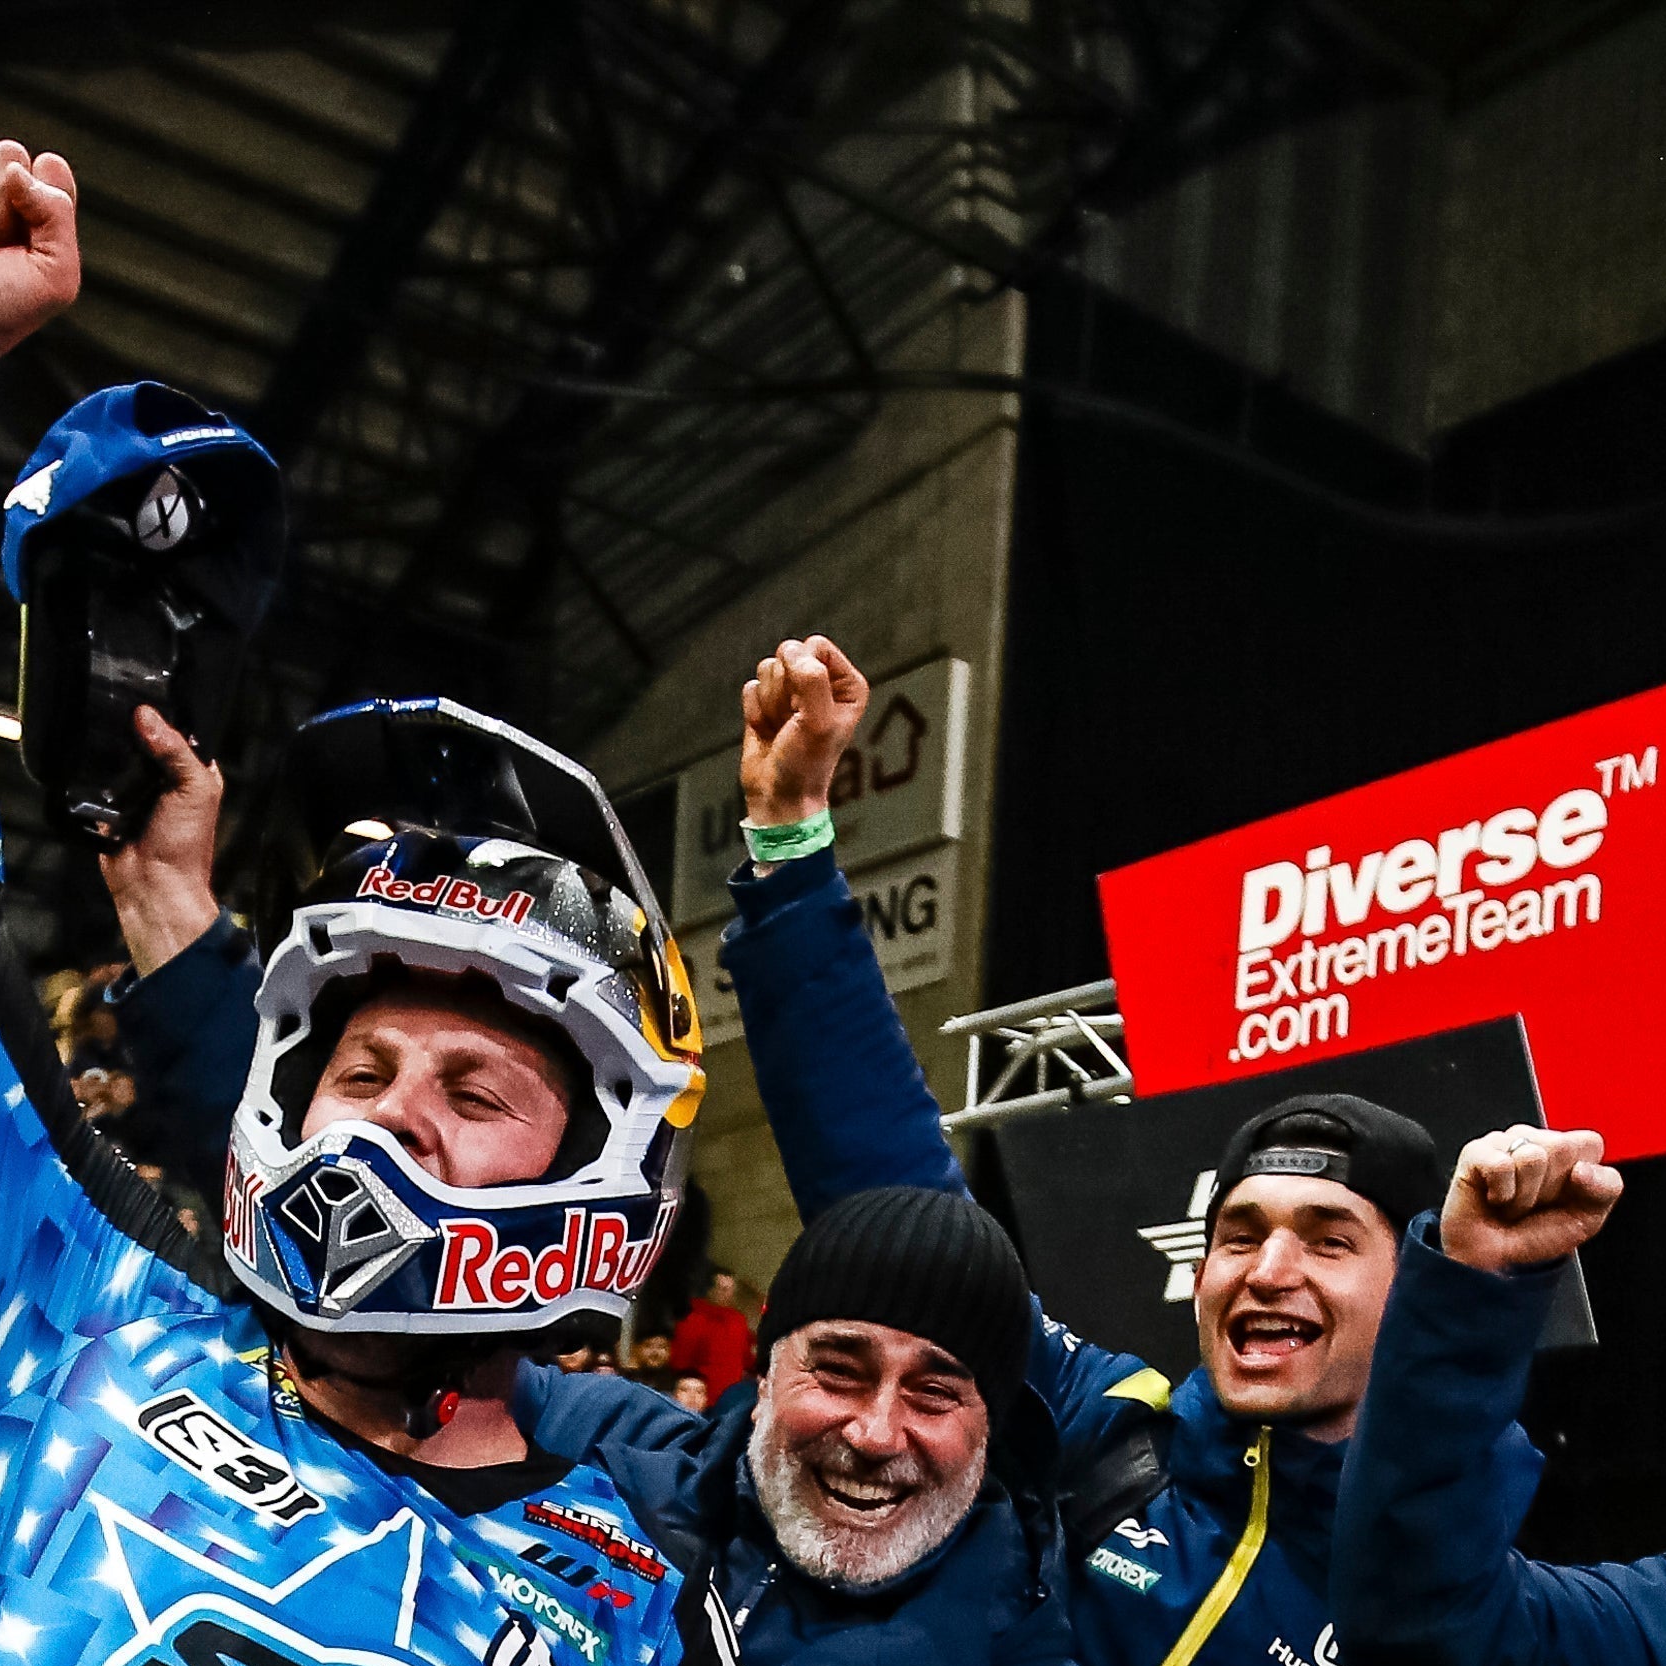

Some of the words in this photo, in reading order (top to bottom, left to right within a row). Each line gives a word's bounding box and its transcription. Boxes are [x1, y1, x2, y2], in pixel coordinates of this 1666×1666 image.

[359, 866, 445, 908] Red
[435, 877, 534, 926] Bull
[1238, 786, 1608, 954] Diverse
[1234, 872, 1602, 1012] ExtremeTeam
[1227, 990, 1351, 1064] .com
[435, 1208, 585, 1310] Red
[586, 1206, 676, 1291] Bull
[539, 1499, 655, 1559] SUPER
[1092, 1548, 1160, 1590] OTOREX
[487, 1564, 601, 1662] MOTOREX
